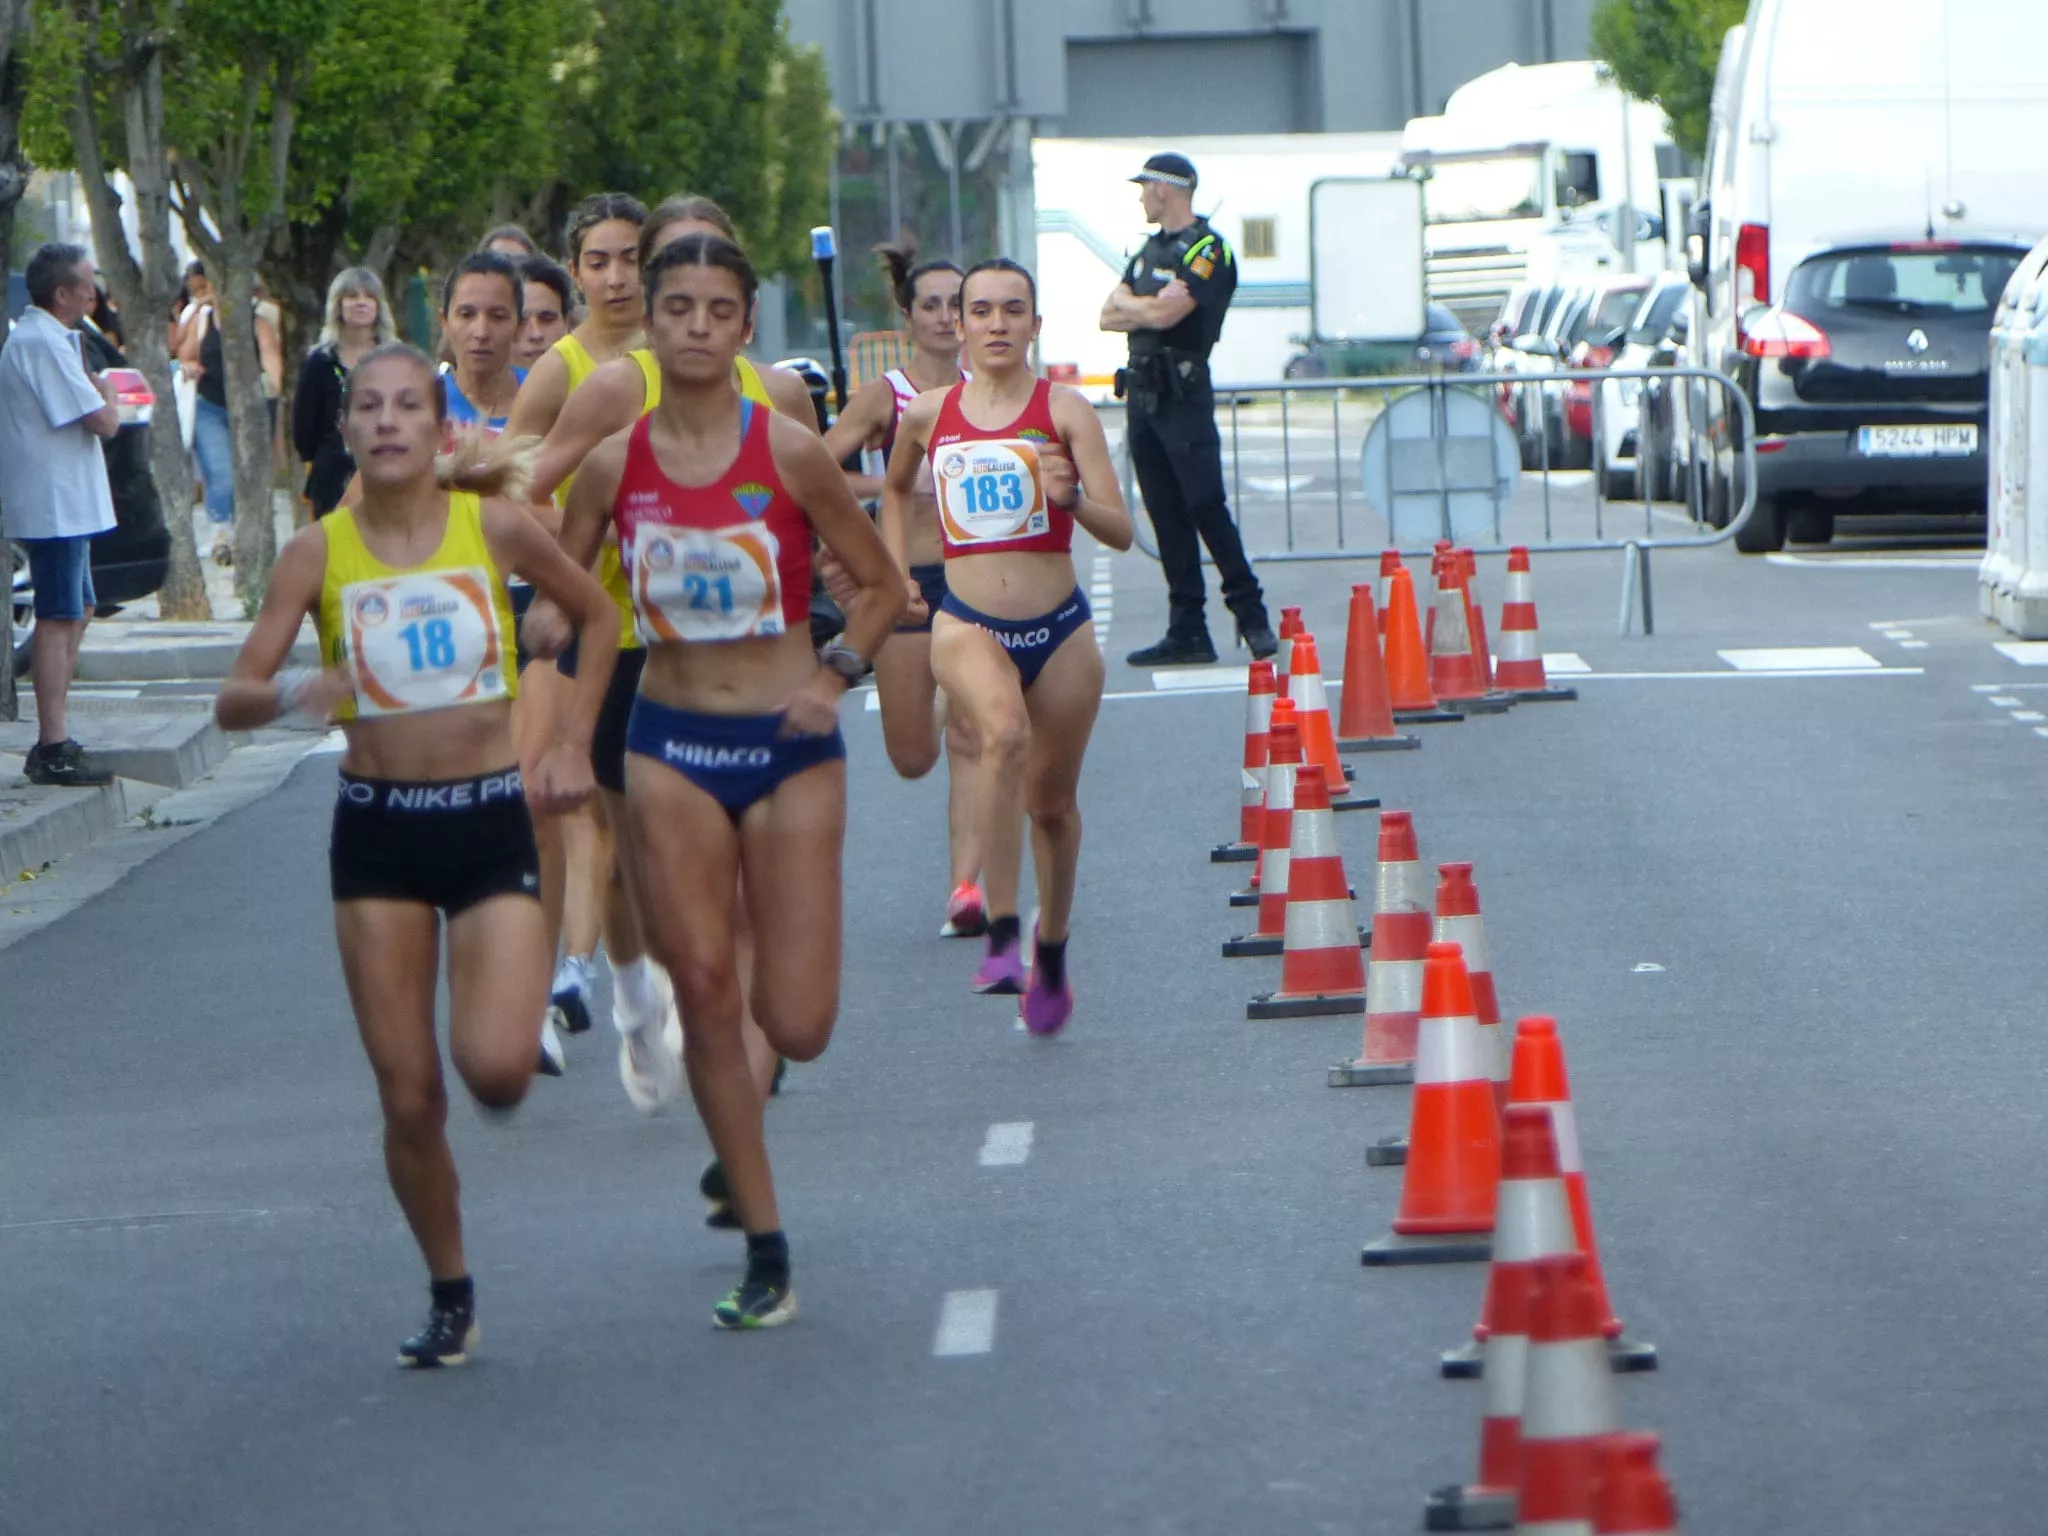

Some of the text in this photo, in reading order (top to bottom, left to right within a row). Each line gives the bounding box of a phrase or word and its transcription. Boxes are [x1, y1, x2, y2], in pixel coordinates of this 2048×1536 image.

[1875, 427, 1971, 446] 5244 HPM
[960, 473, 1024, 514] 183
[683, 573, 734, 614] 21
[398, 618, 456, 671] 18
[387, 782, 475, 809] NIKE
